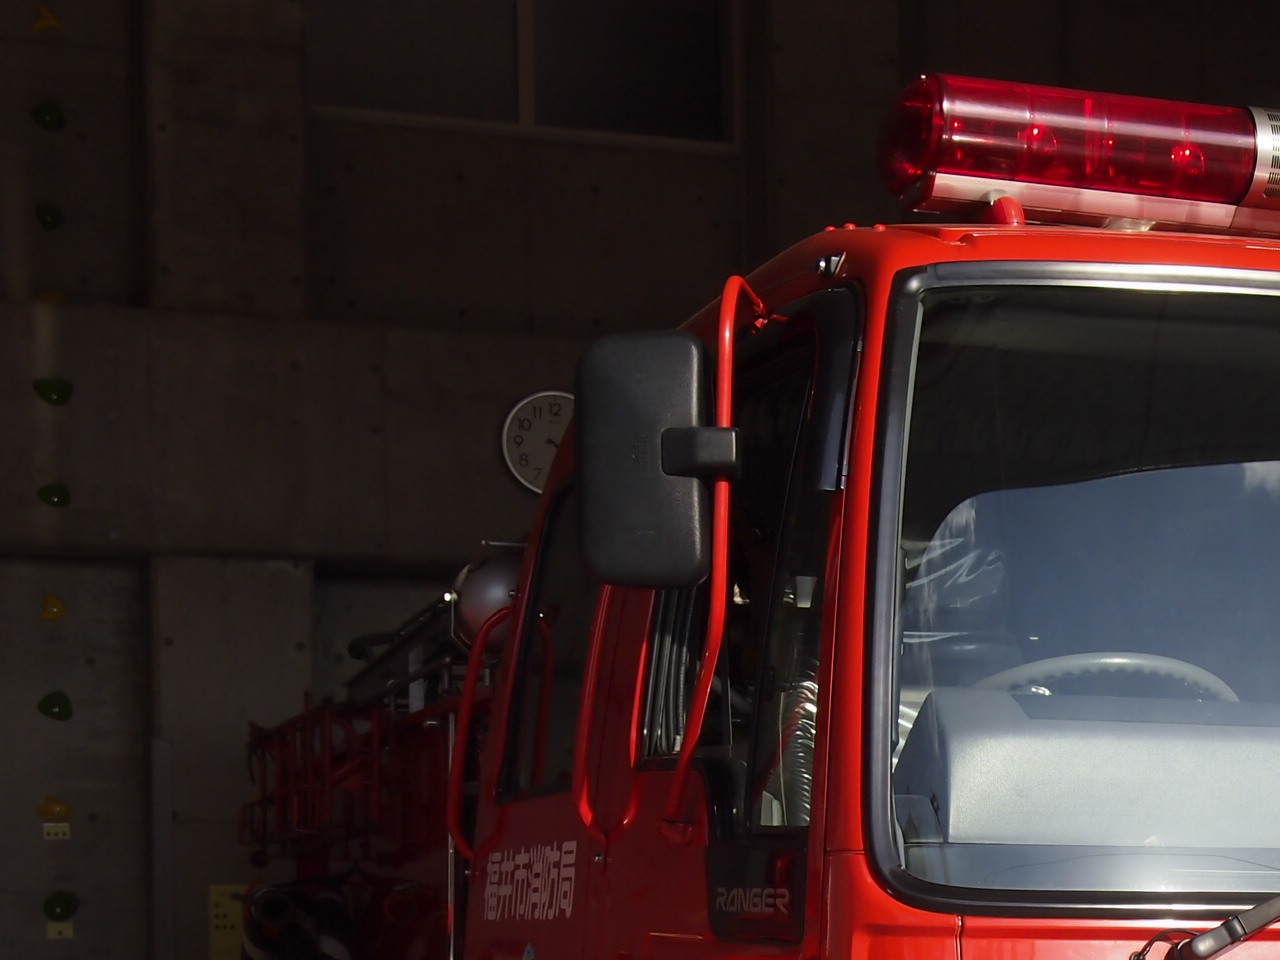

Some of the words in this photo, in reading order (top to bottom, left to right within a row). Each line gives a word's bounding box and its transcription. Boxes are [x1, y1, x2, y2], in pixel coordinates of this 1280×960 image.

[533, 405, 543, 419] 11
[549, 402, 562, 417] 12
[518, 417, 532, 432] 10
[513, 433, 524, 448] 9
[519, 452, 529, 468] 8
[534, 466, 543, 481] 7
[483, 839, 578, 921] 福井市消防局
[714, 886, 791, 915] RANGER
